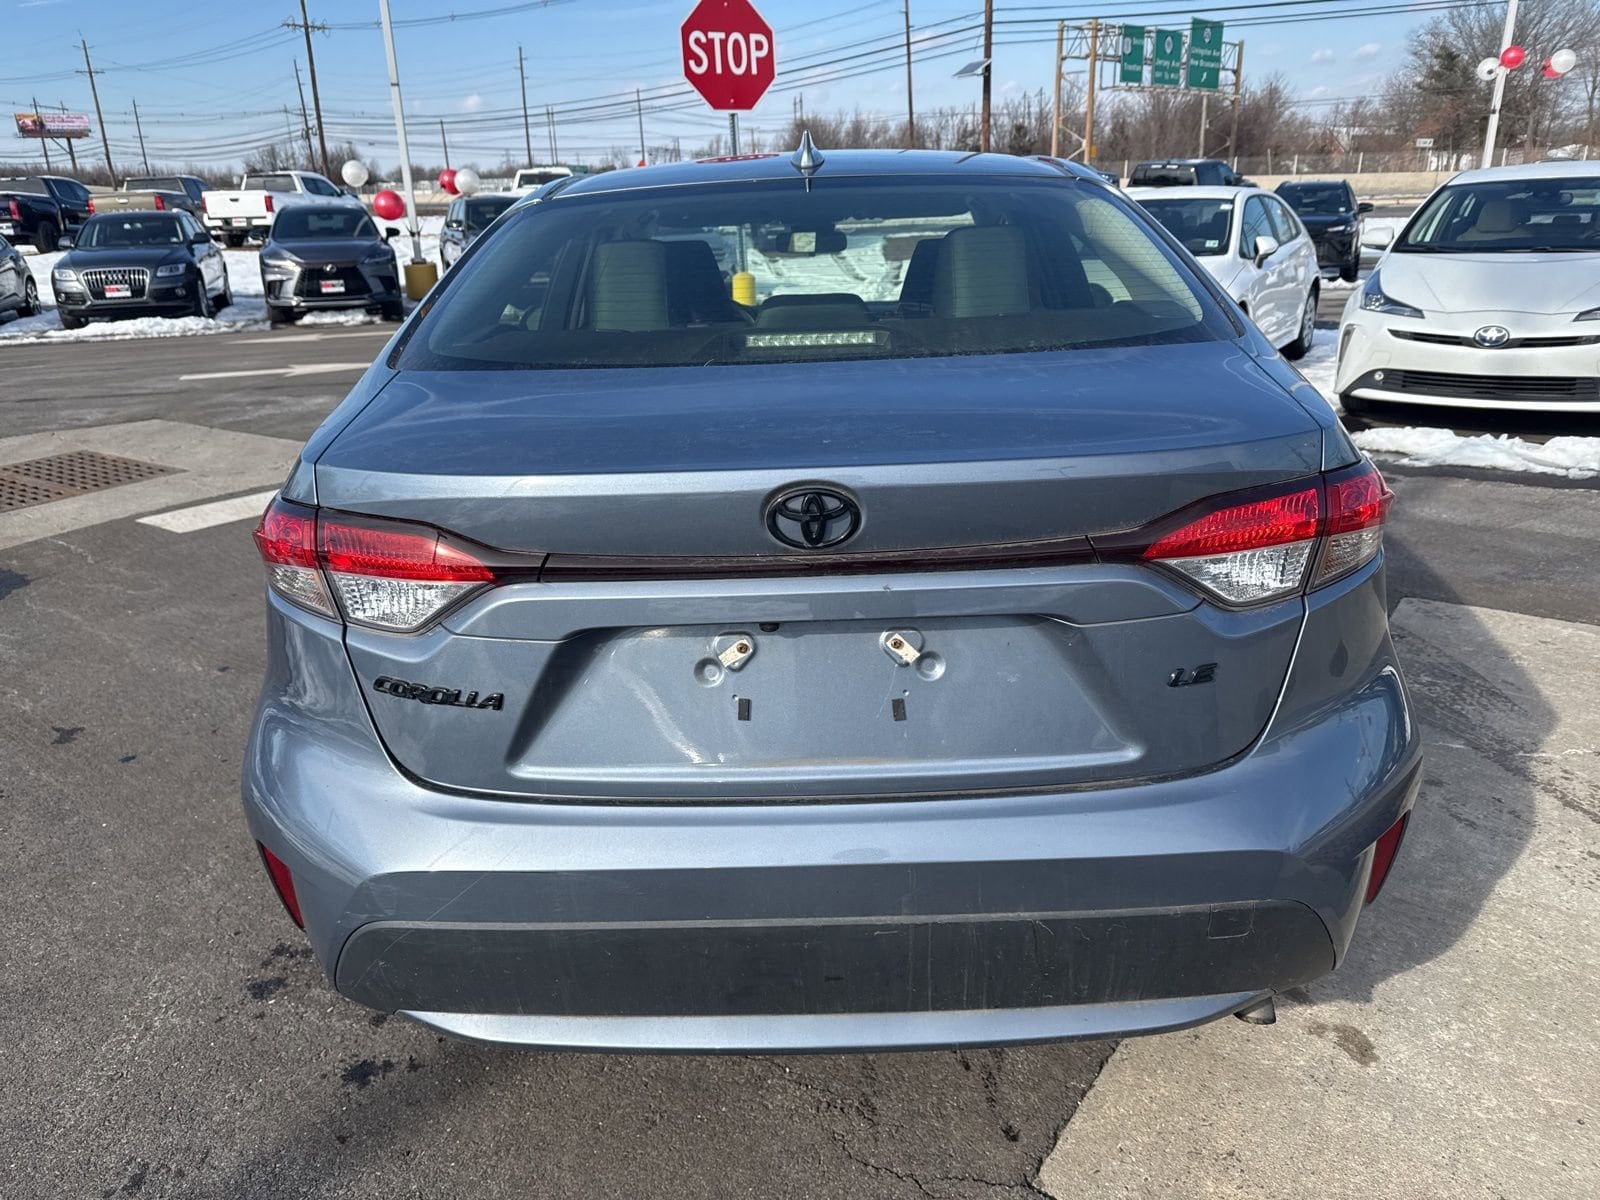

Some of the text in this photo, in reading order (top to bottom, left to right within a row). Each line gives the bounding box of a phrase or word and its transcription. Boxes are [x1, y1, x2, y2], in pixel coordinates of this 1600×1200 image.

[688, 30, 769, 76] STOP
[1166, 662, 1218, 687] LE
[373, 675, 505, 711] COROLLA
